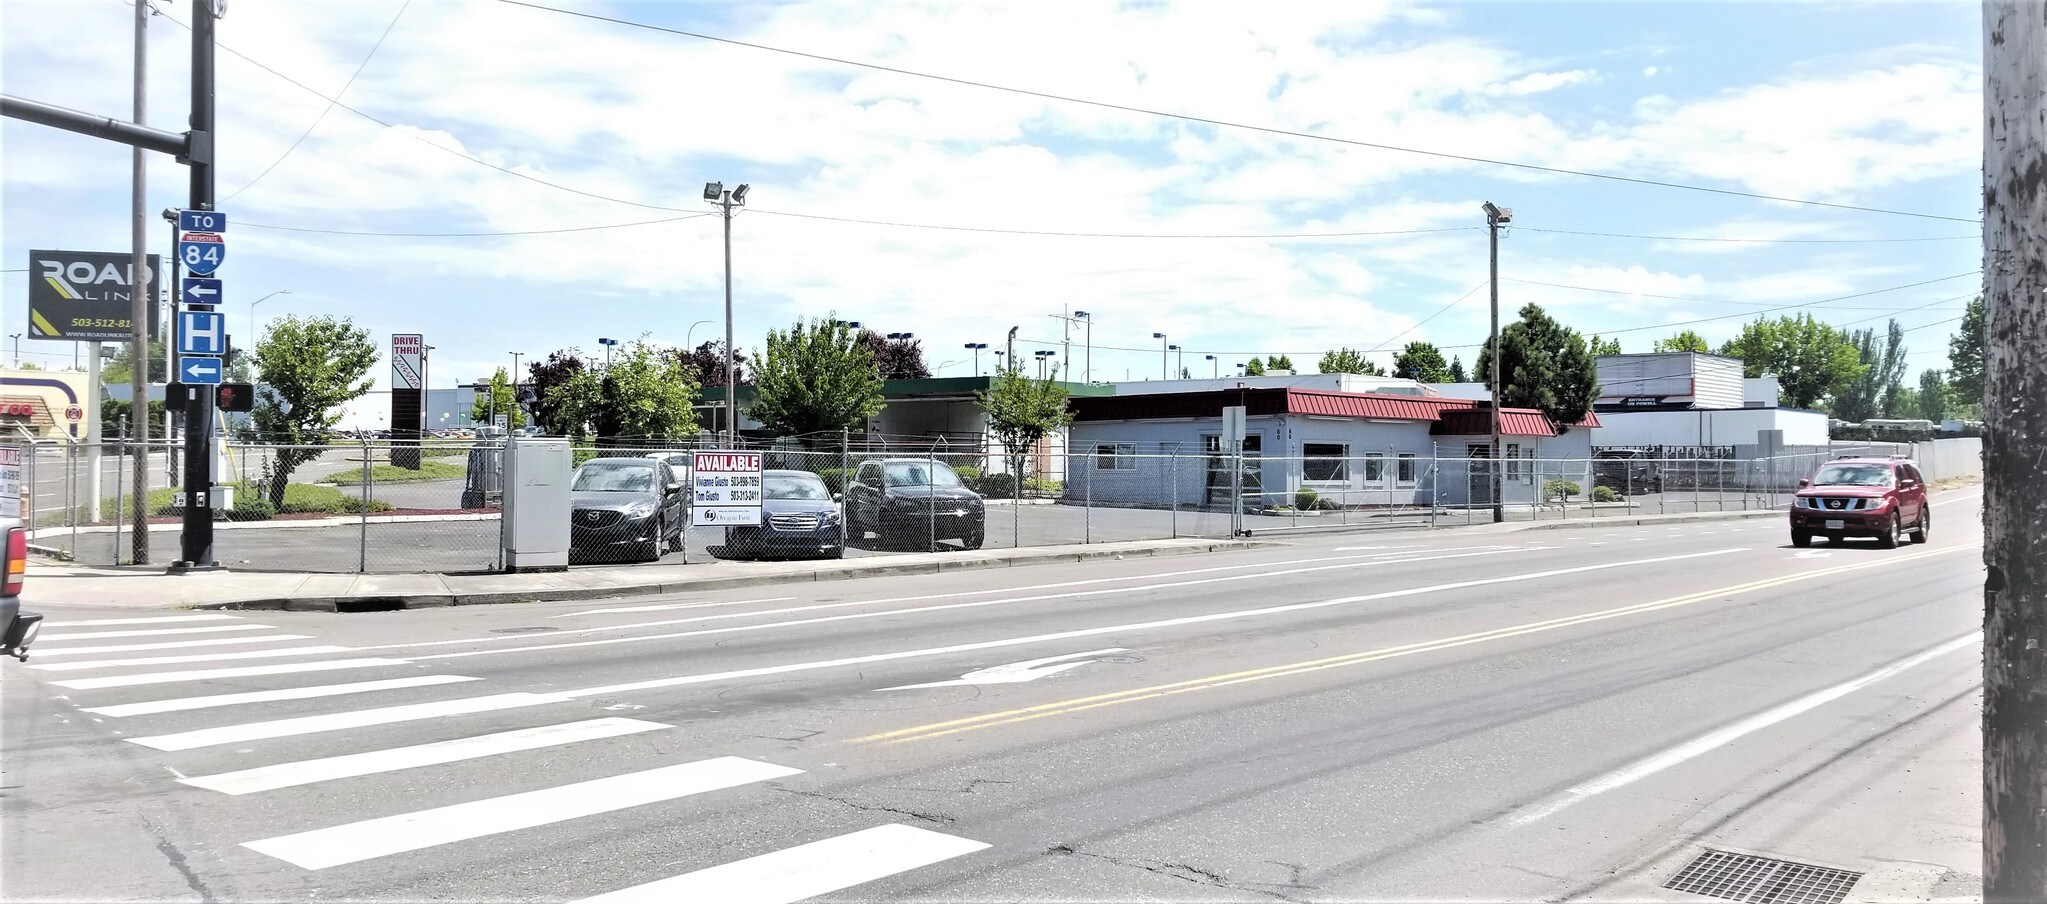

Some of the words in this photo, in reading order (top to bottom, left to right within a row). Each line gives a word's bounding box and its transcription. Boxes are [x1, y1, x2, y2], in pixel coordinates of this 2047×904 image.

[191, 215, 214, 228] TO
[185, 245, 219, 265] 84
[184, 314, 218, 351] H
[394, 337, 419, 345] DRIVE
[394, 346, 419, 355] THRU
[697, 455, 759, 471] AVAILABLE
[696, 476, 714, 487] Vivianne
[715, 476, 728, 487] Giusto
[695, 490, 705, 501] Tom
[705, 490, 719, 501] Giusto
